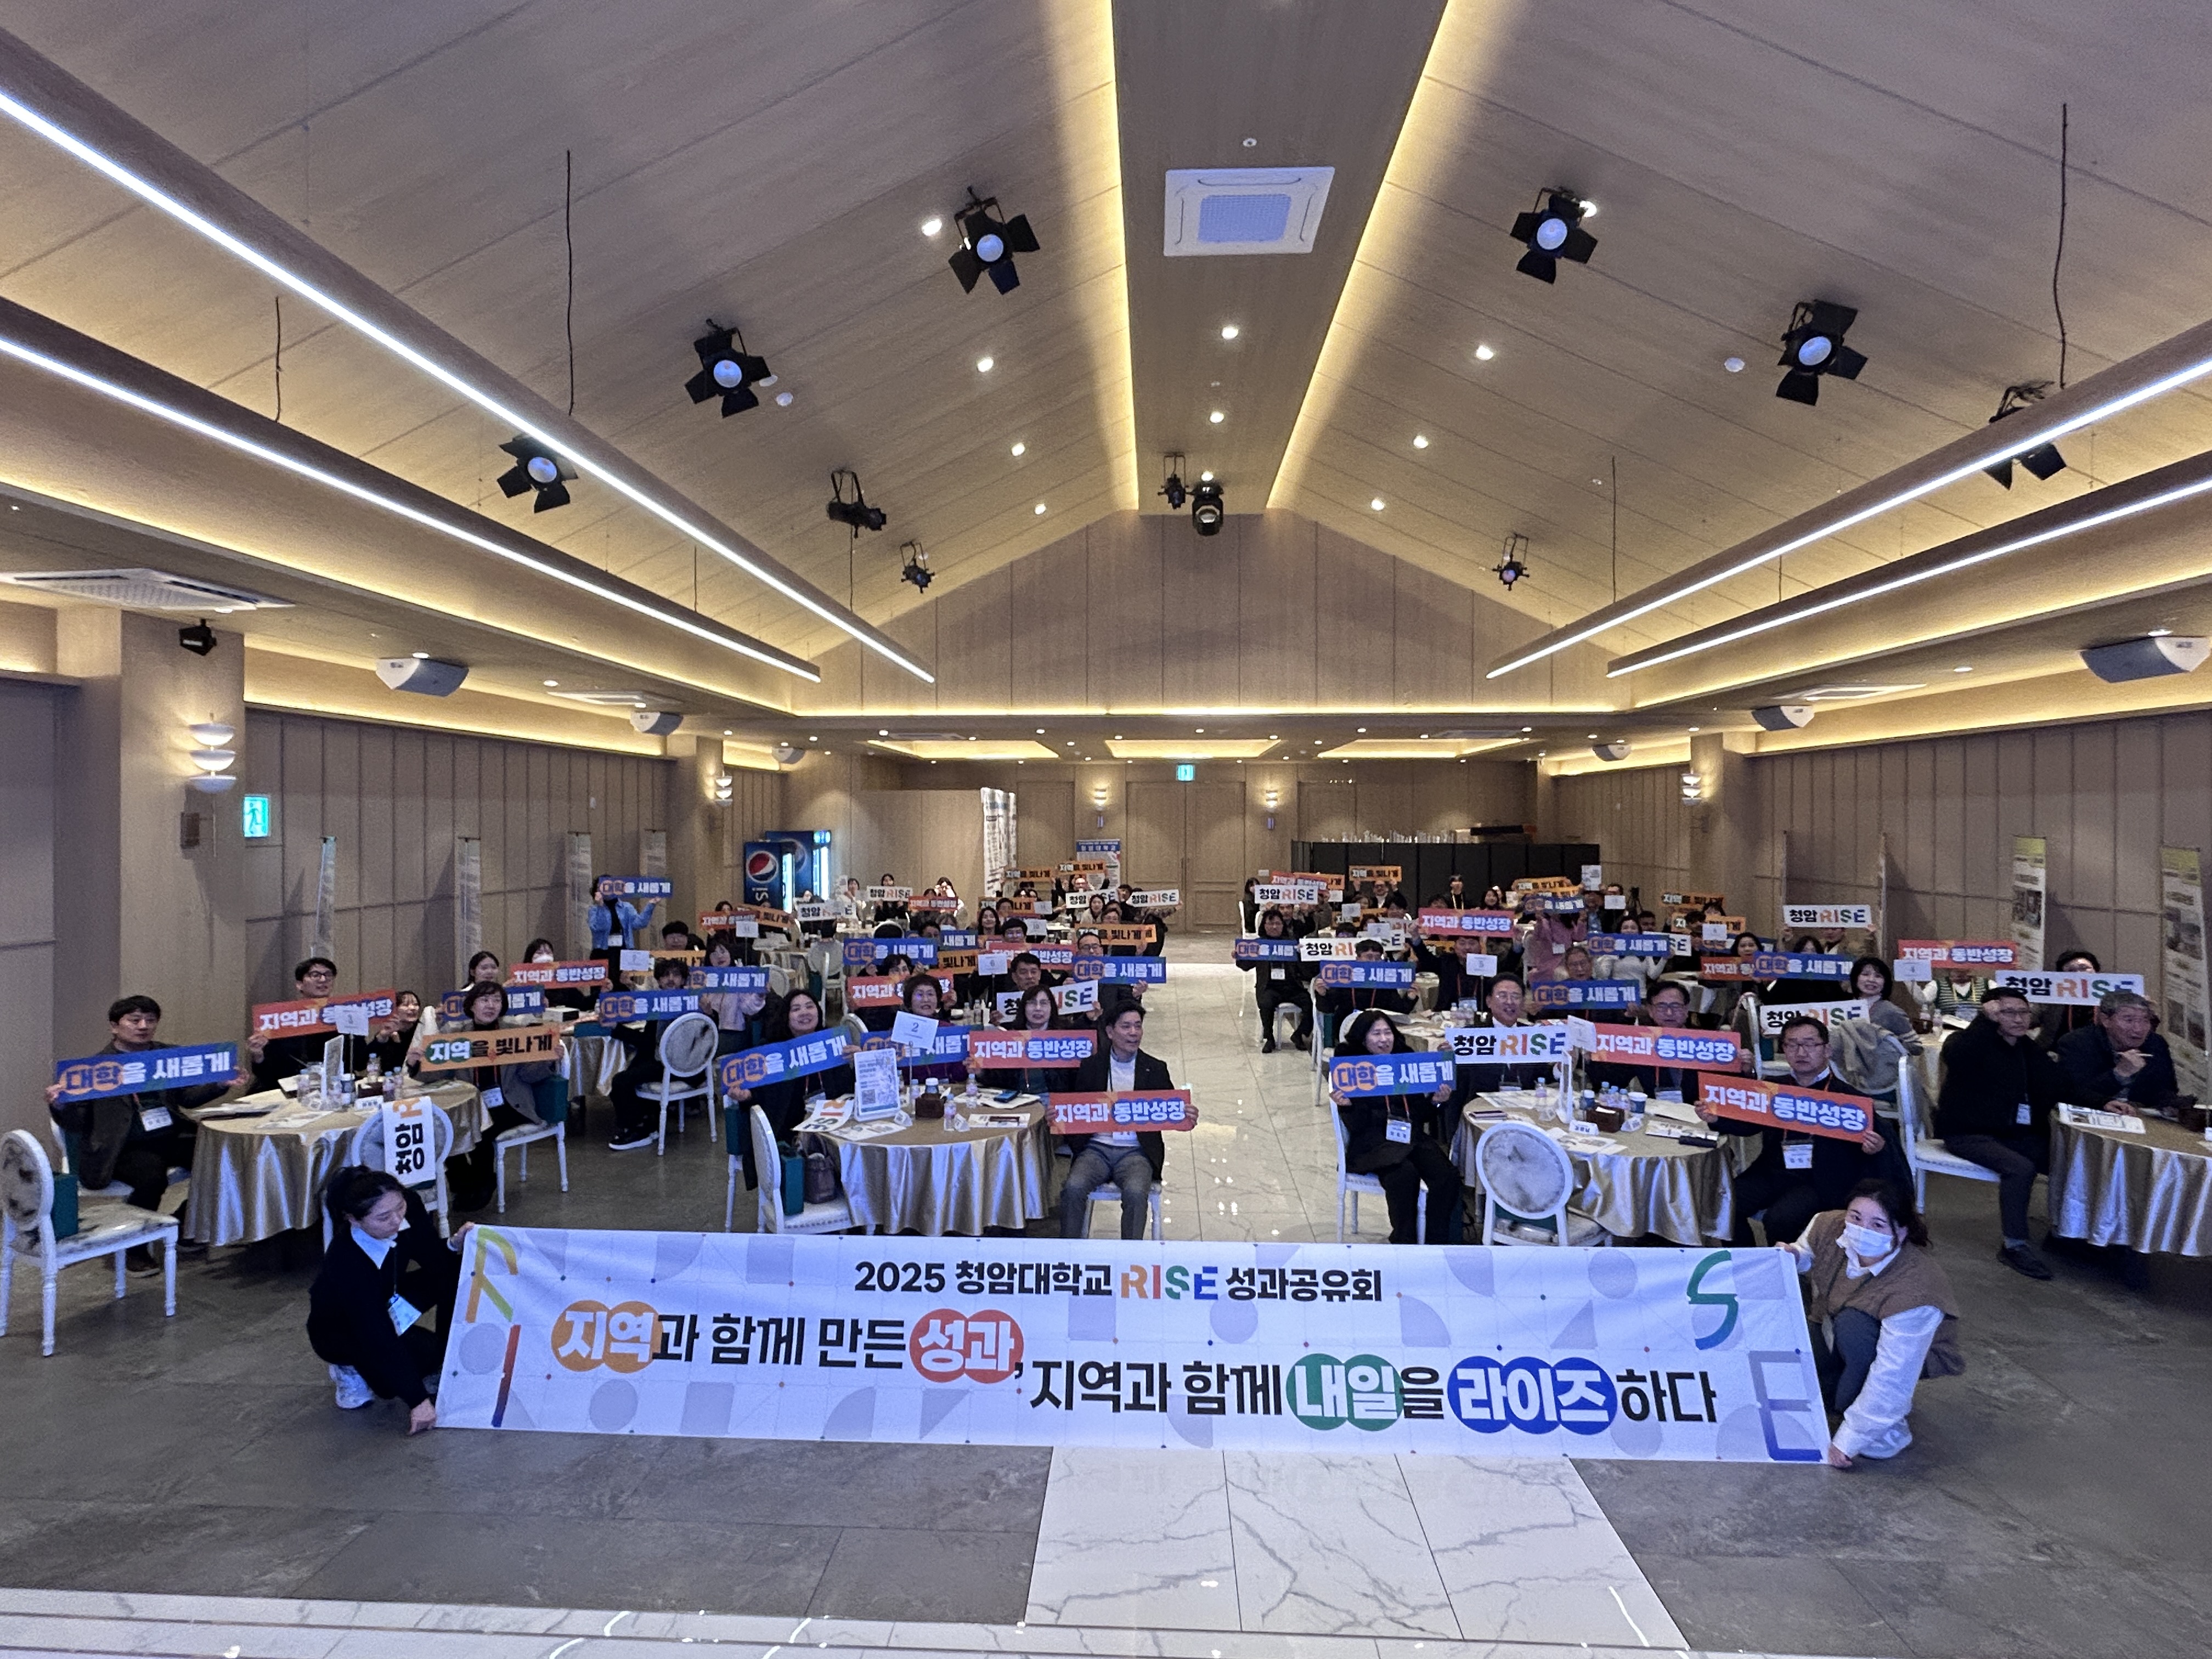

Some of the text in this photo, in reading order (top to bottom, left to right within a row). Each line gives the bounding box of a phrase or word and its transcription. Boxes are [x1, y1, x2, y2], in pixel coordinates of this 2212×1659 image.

[637, 882, 670, 894] 새롭게
[1259, 888, 1314, 900] 청암RISE
[1069, 891, 1115, 905] 청암SE
[1132, 892, 1177, 904] 청암RISE
[1422, 915, 1459, 929] 지역과
[1461, 915, 1512, 932] 동반성장
[1790, 909, 1866, 923] 청암RISE
[1111, 929, 1141, 940] 빛나게
[1272, 945, 1296, 957] 새롭
[1306, 943, 1353, 956] 청암RI
[1629, 939, 1667, 952] 새롭게
[943, 956, 976, 968] 빛나게
[1903, 947, 2013, 963] 지역과 동반성장
[514, 966, 606, 983] 지역과 동반성장
[1077, 962, 1163, 977] 대학을 새롭게
[1324, 967, 1413, 983] 대학을 새롭게
[1703, 963, 1737, 975] 지역과
[1807, 959, 1853, 975] 새롭게
[691, 972, 766, 988] 학을 새롭게
[507, 991, 541, 1009] 롭게
[853, 984, 894, 1000] 지역과
[1538, 986, 1636, 1003] 대학을 새롭게
[652, 995, 699, 1012] 새롭게
[1003, 986, 1093, 1016] 청ISE
[259, 998, 393, 1031] 지역과 동성장
[911, 1022, 919, 1032] 2
[429, 1034, 553, 1061] 지역을 빛나게
[974, 1039, 1092, 1059] 지역과 동반성장
[1454, 1032, 1567, 1057] 청암RISE
[1597, 1034, 1735, 1063] 지역과 동반성장
[726, 1035, 848, 1085] 대학을 새롭게
[66, 1051, 230, 1091] 대학을 새롭게
[1338, 1060, 1453, 1087] 대학을 새롭게
[1054, 1099, 1186, 1123] 지역과 동반성장
[1704, 1085, 1866, 1132] 지역과 동반성장
[392, 1098, 424, 1175] 청암R
[855, 1260, 1382, 1302] 2025 청암대학교 RISE 성과공유회
[558, 1309, 1024, 1380] 지역과 함께 만든 성과,
[1029, 1358, 1718, 1424] 지역과 함께 내일을 라이즈하다
